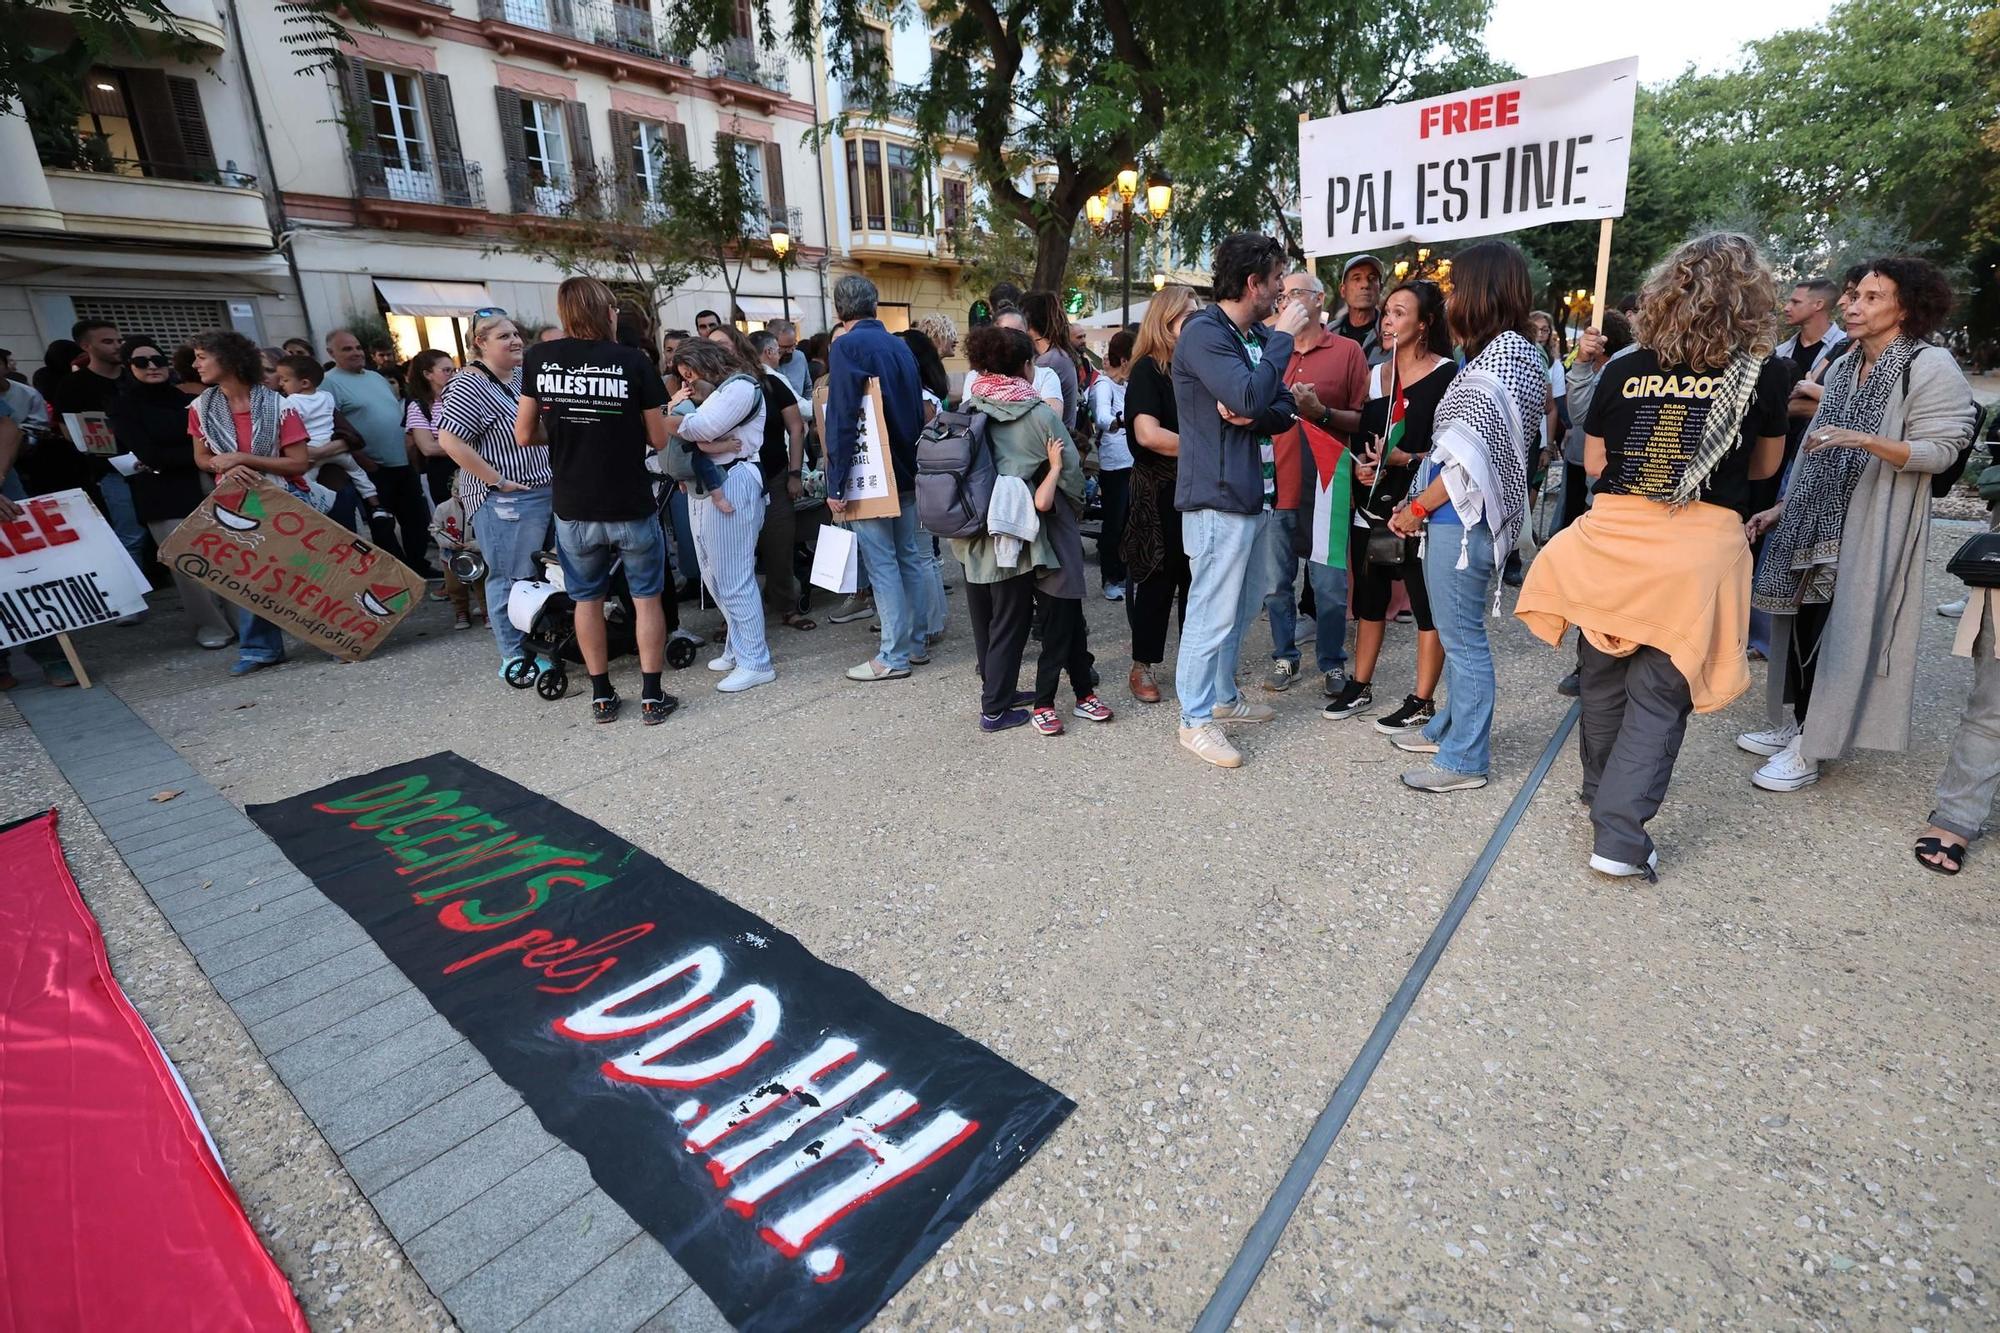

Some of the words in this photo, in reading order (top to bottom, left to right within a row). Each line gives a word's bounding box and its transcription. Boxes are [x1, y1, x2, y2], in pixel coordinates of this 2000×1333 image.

[1420, 91, 1520, 139] FREE
[1327, 135, 1593, 237] PALESTINE
[536, 373, 629, 399] PALESTINE
[541, 361, 563, 372] حرة
[566, 363, 624, 375] فلسطين
[1622, 375, 1724, 399] GIRA202
[554, 397, 590, 405] CISJORDANIA
[851, 455, 870, 467] SRAEL
[1645, 446, 1681, 454] BARCELONA
[0, 499, 80, 558] EE
[272, 511, 377, 576] OLAS
[0, 571, 120, 645] ALESTINE
[312, 774, 614, 932] DOCENTS
[443, 923, 656, 994] pels
[551, 944, 980, 1284] DD.HH.
